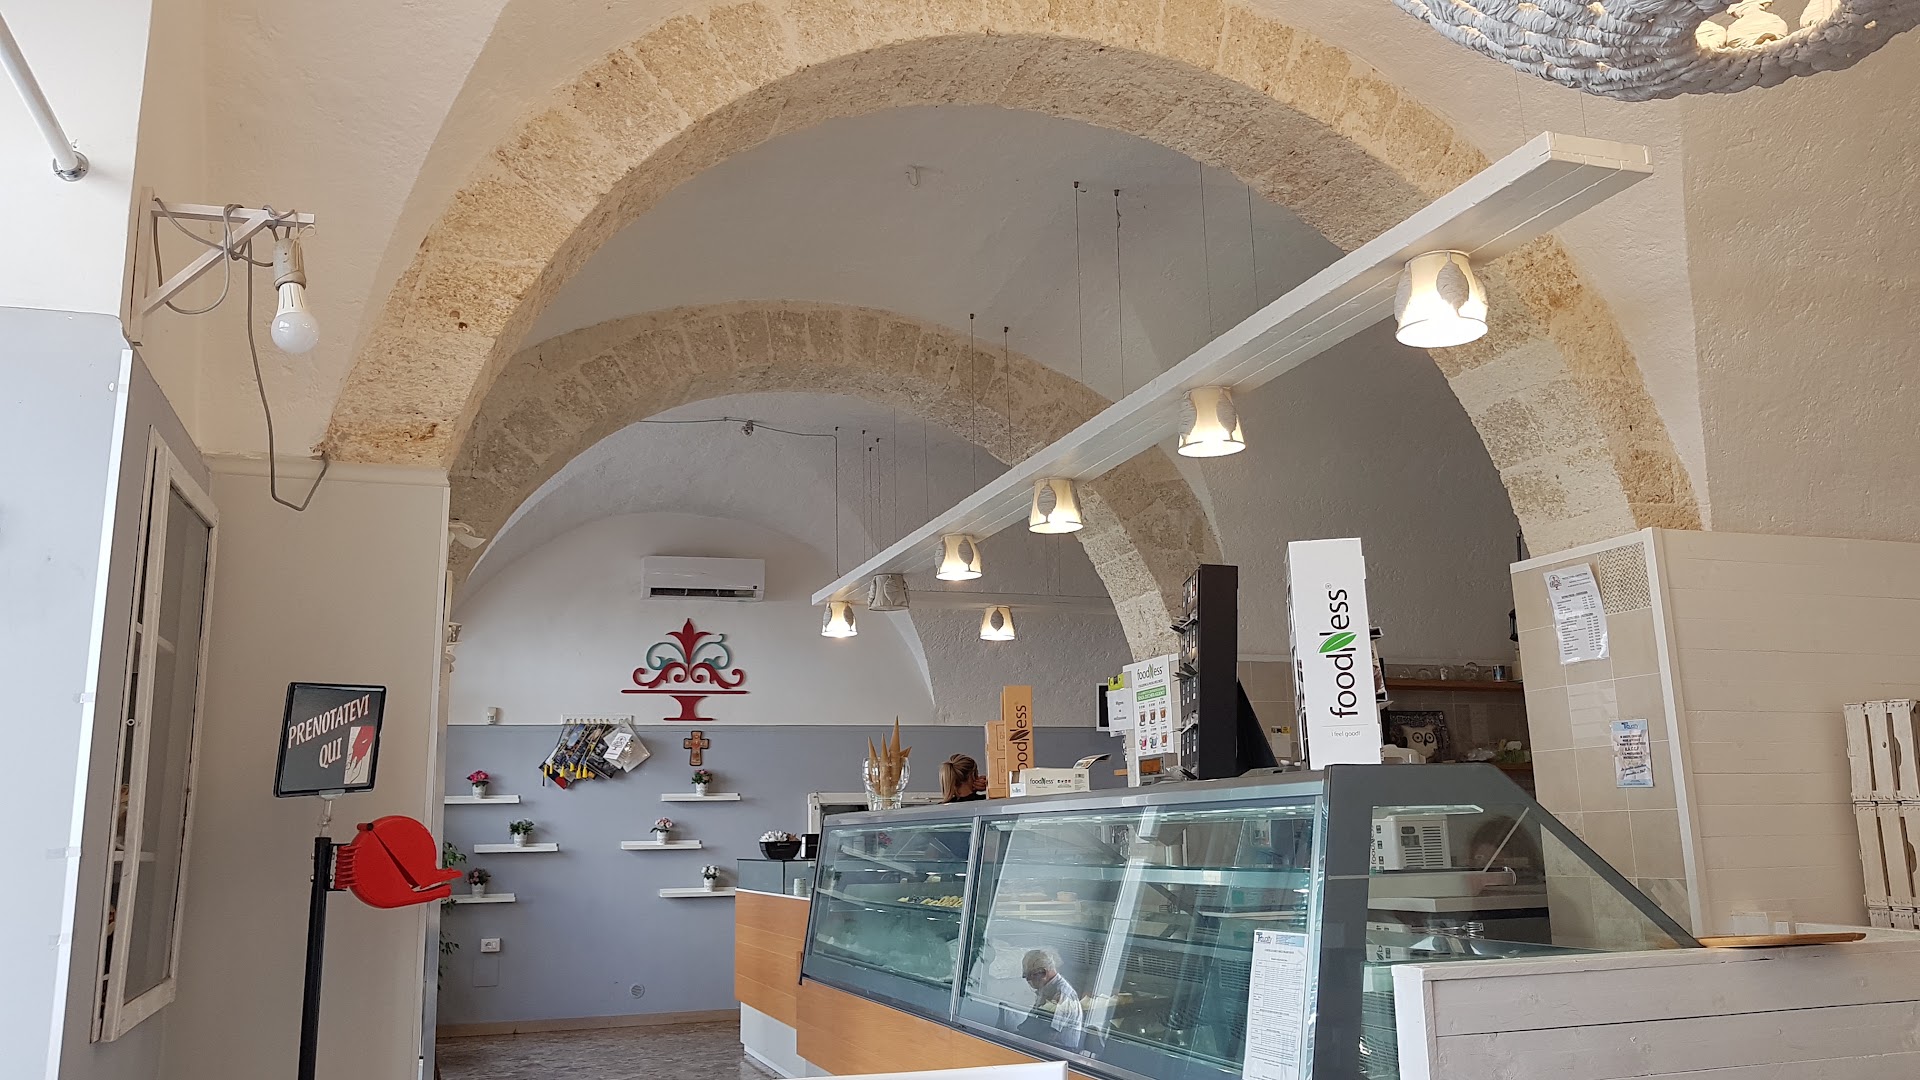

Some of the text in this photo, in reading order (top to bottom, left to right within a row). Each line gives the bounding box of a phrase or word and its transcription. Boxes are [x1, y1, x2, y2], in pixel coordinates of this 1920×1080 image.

[288, 694, 370, 749] PRENOTATEVI
[1009, 705, 1030, 770] oodNess
[319, 738, 342, 769] QUI
